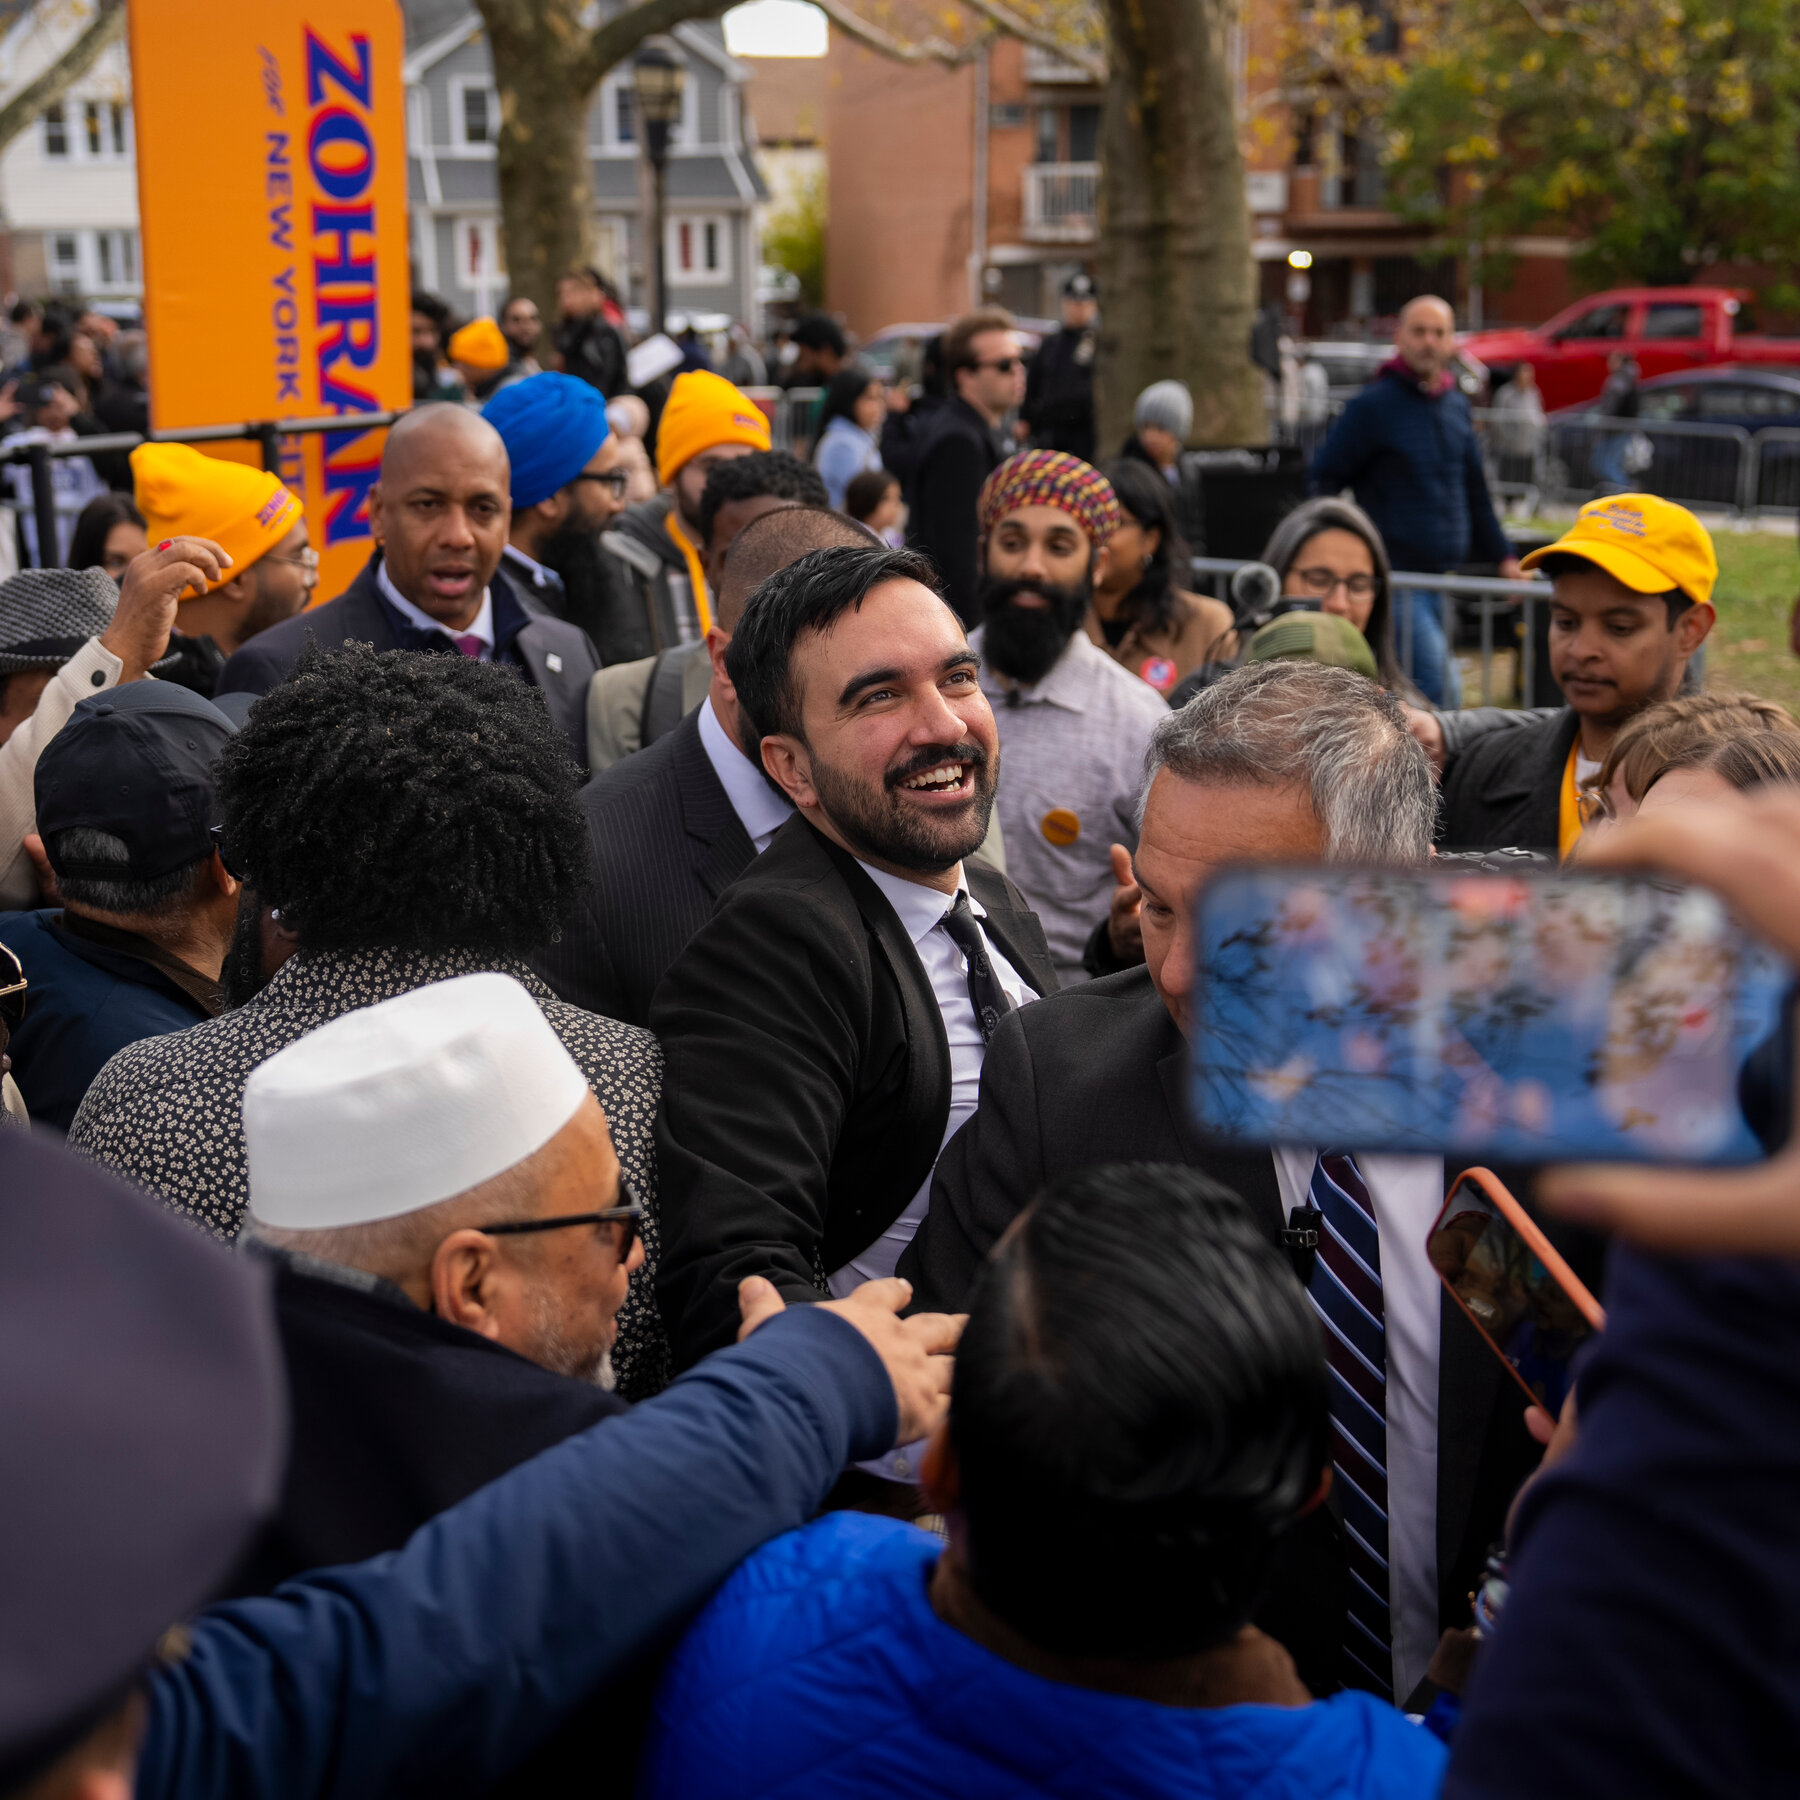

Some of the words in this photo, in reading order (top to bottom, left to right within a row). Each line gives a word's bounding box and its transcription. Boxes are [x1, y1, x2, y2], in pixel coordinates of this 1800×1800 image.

[267, 132, 294, 251] NEW
[272, 267, 301, 402] YORK
[304, 23, 381, 545] ZOHRAN
